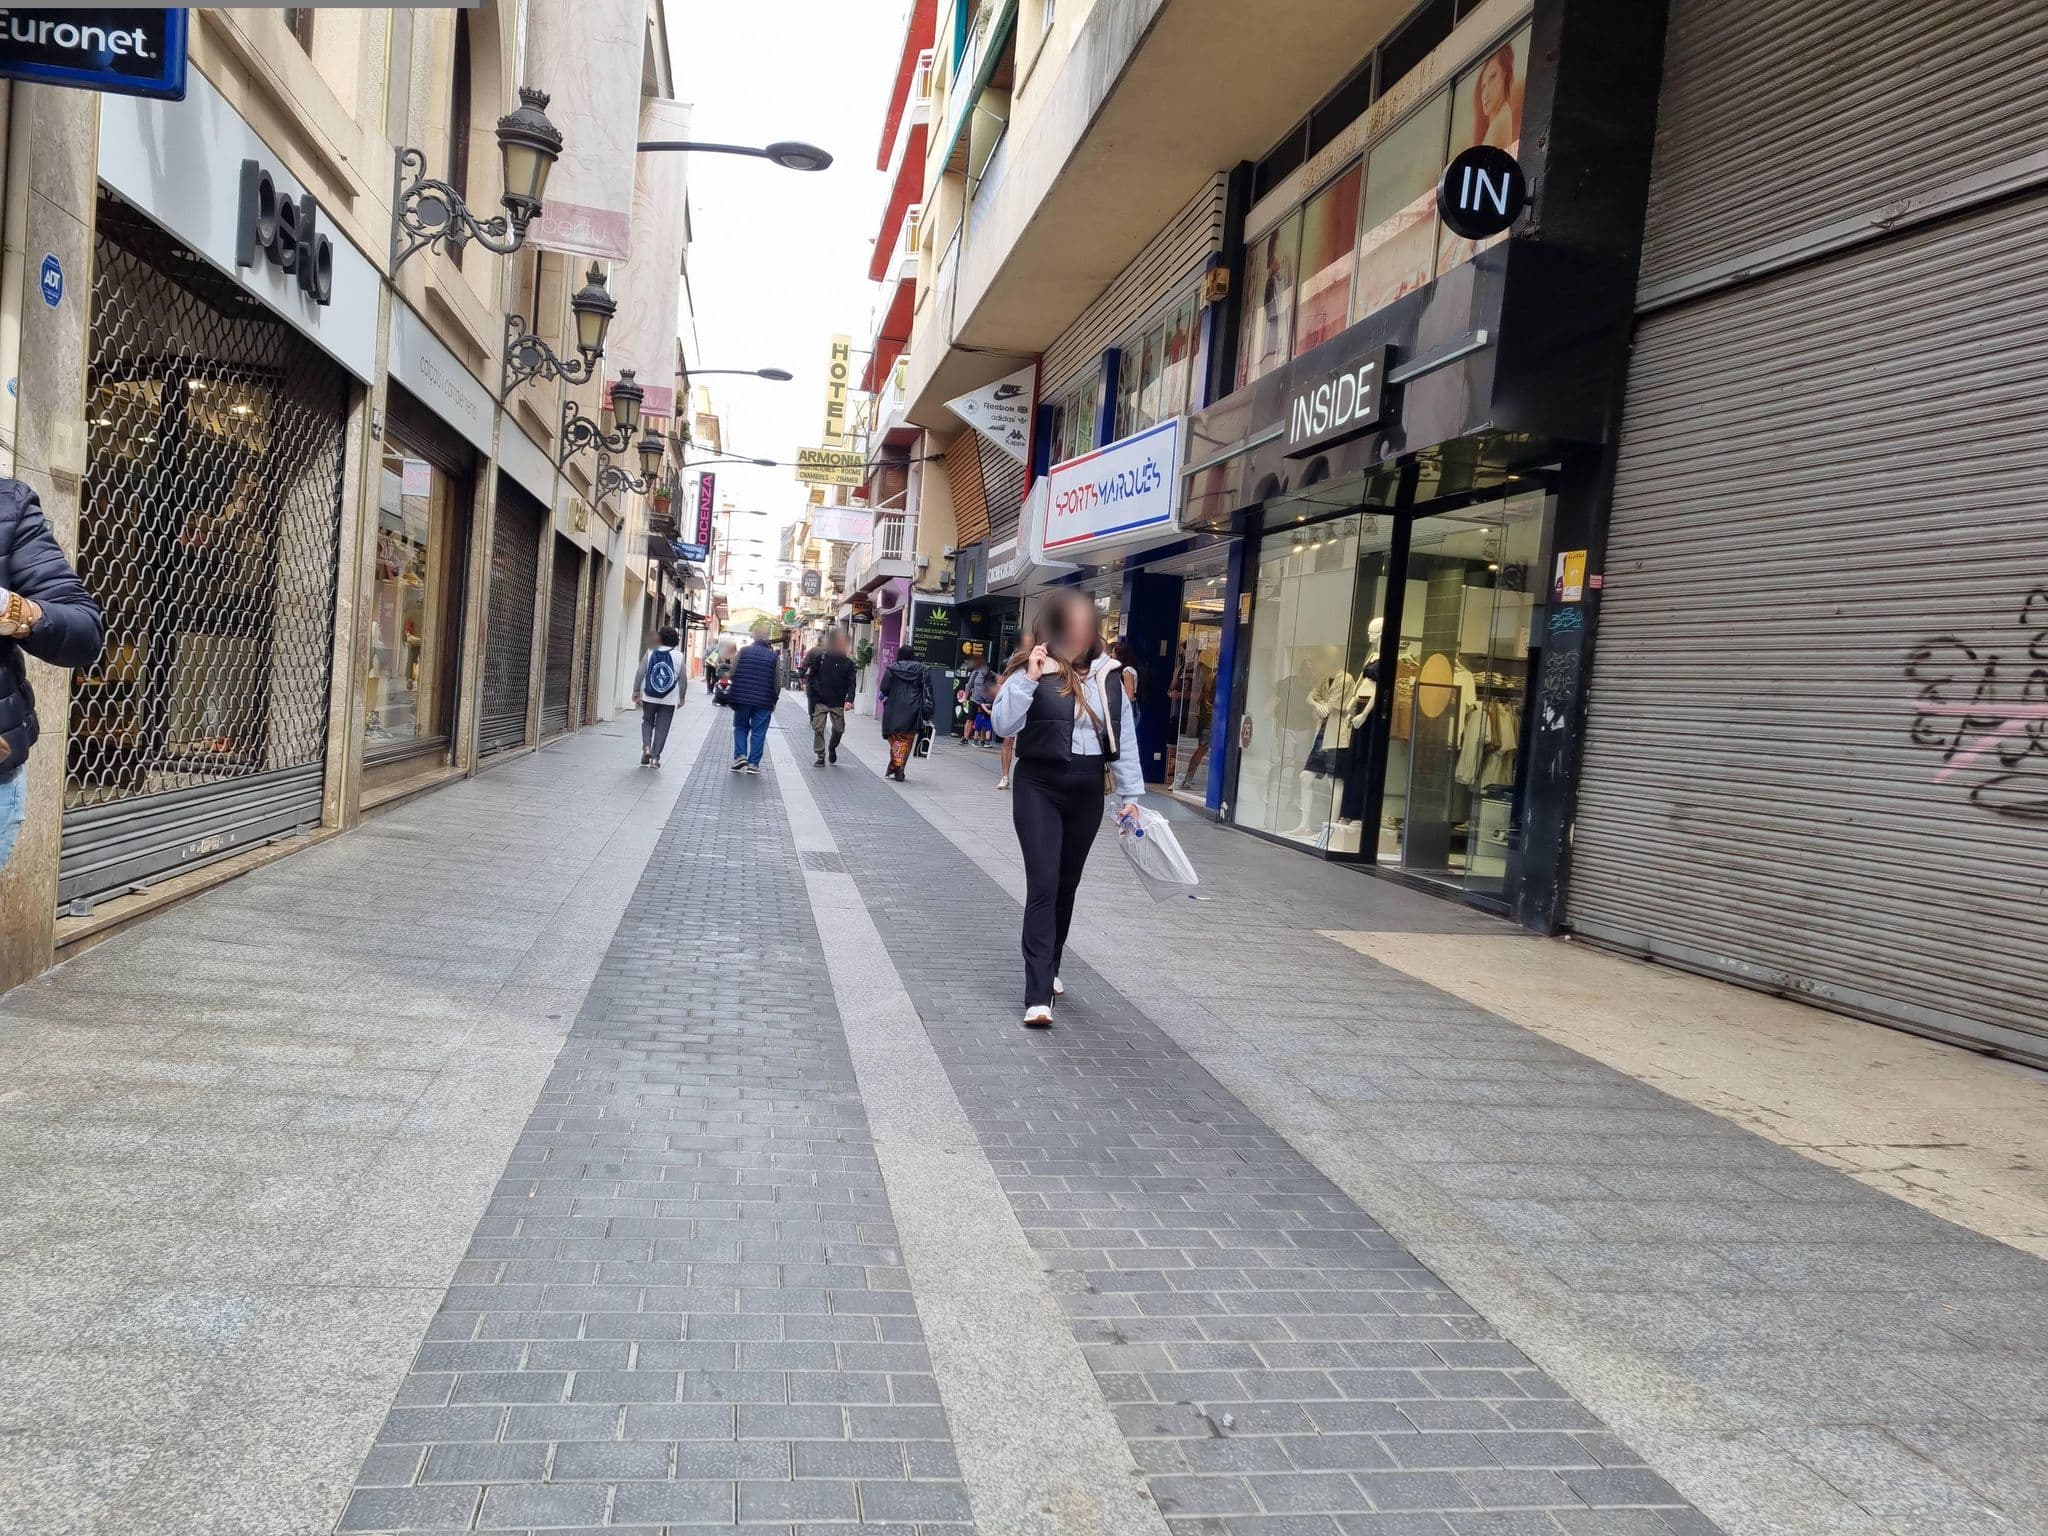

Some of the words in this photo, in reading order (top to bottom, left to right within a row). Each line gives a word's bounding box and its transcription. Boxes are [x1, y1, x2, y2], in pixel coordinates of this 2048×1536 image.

[1460, 165, 1511, 216] IN
[44, 270, 61, 290] ADT
[825, 343, 849, 438] HOTEL
[999, 384, 1022, 393] NIKE
[983, 403, 1014, 412] Reebok
[1290, 361, 1375, 444] INSIDE
[991, 414, 1016, 423] adidas
[1005, 439, 1026, 447] Kappa
[799, 450, 862, 465] ARMONIA
